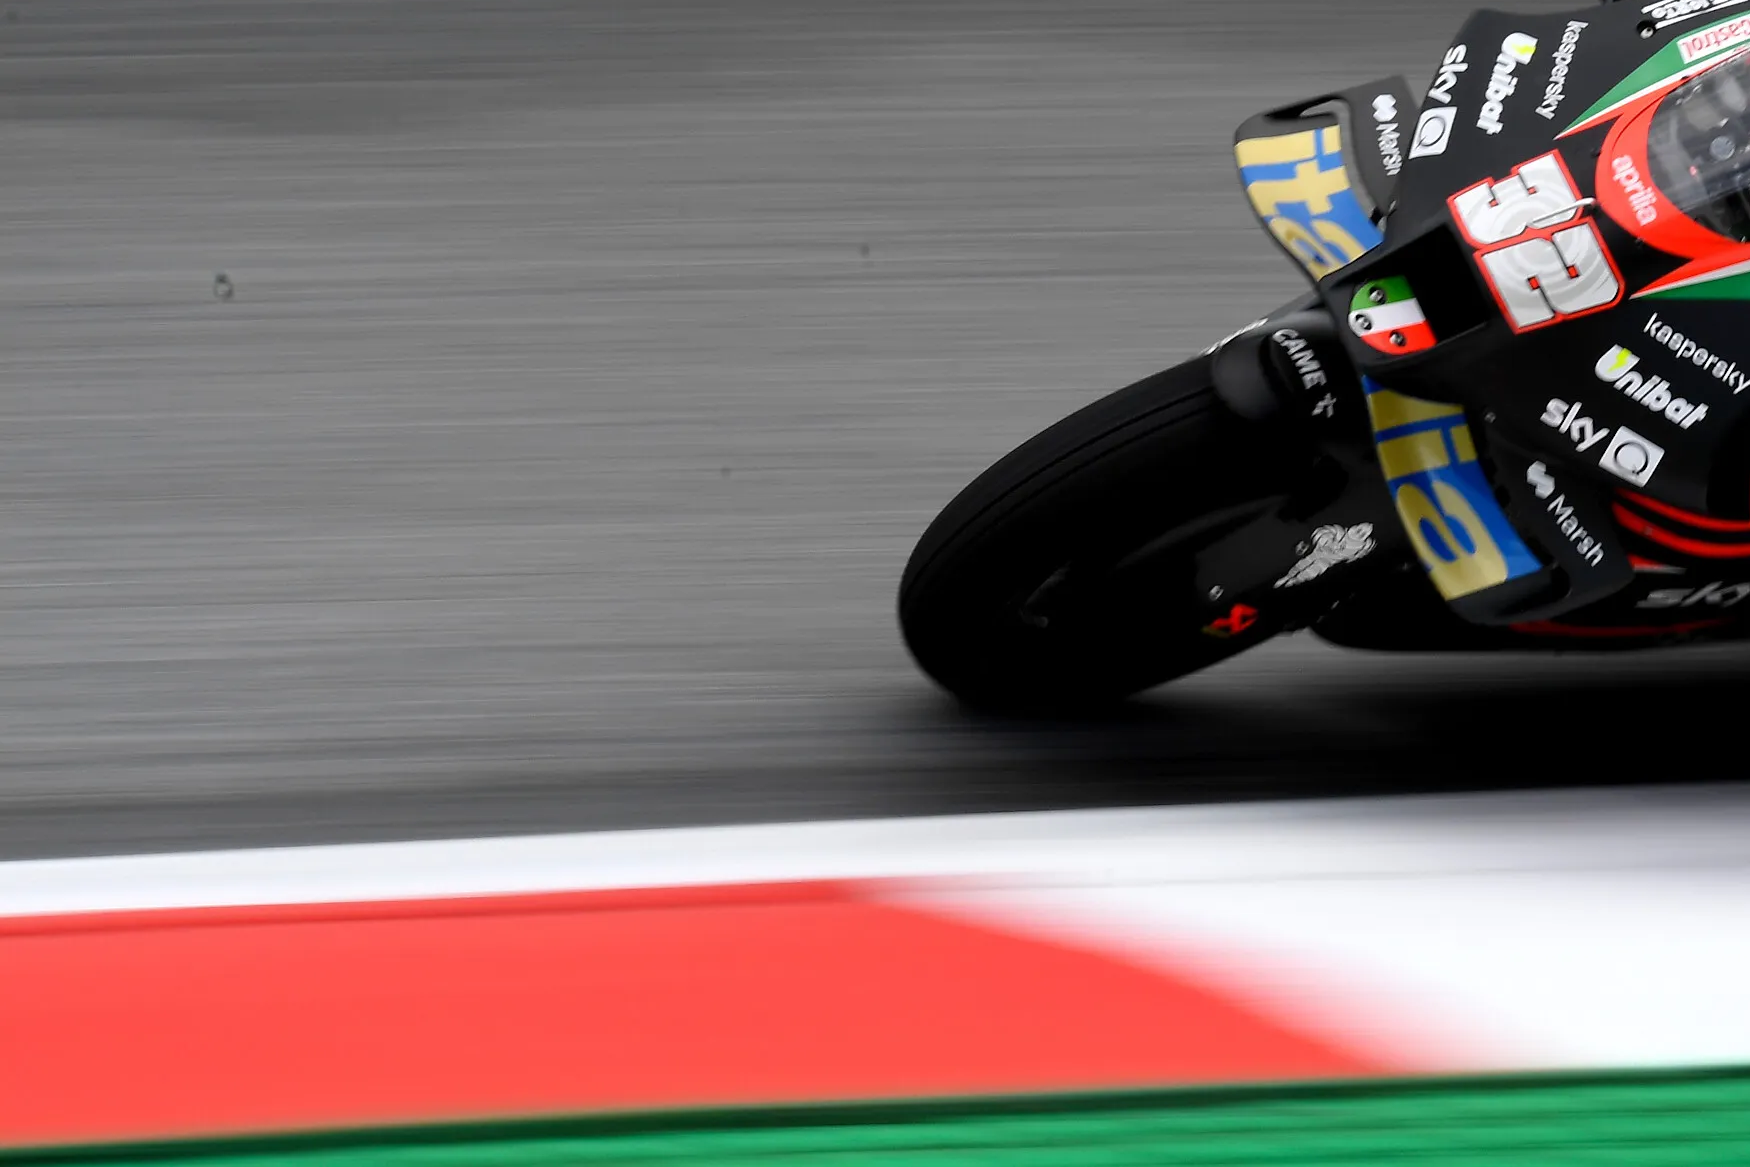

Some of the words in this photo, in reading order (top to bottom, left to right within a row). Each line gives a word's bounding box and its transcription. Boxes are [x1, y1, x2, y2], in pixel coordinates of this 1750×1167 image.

[1428, 44, 1469, 104] sky
[1476, 32, 1539, 135] Unibat
[1535, 20, 1590, 120] kaspersky
[1611, 154, 1658, 226] aprilia
[1449, 150, 1623, 332] 32
[1272, 327, 1328, 390] CAME
[1594, 344, 1709, 431] Unibat
[1539, 396, 1611, 453] sky
[1546, 493, 1605, 568] Marsh
